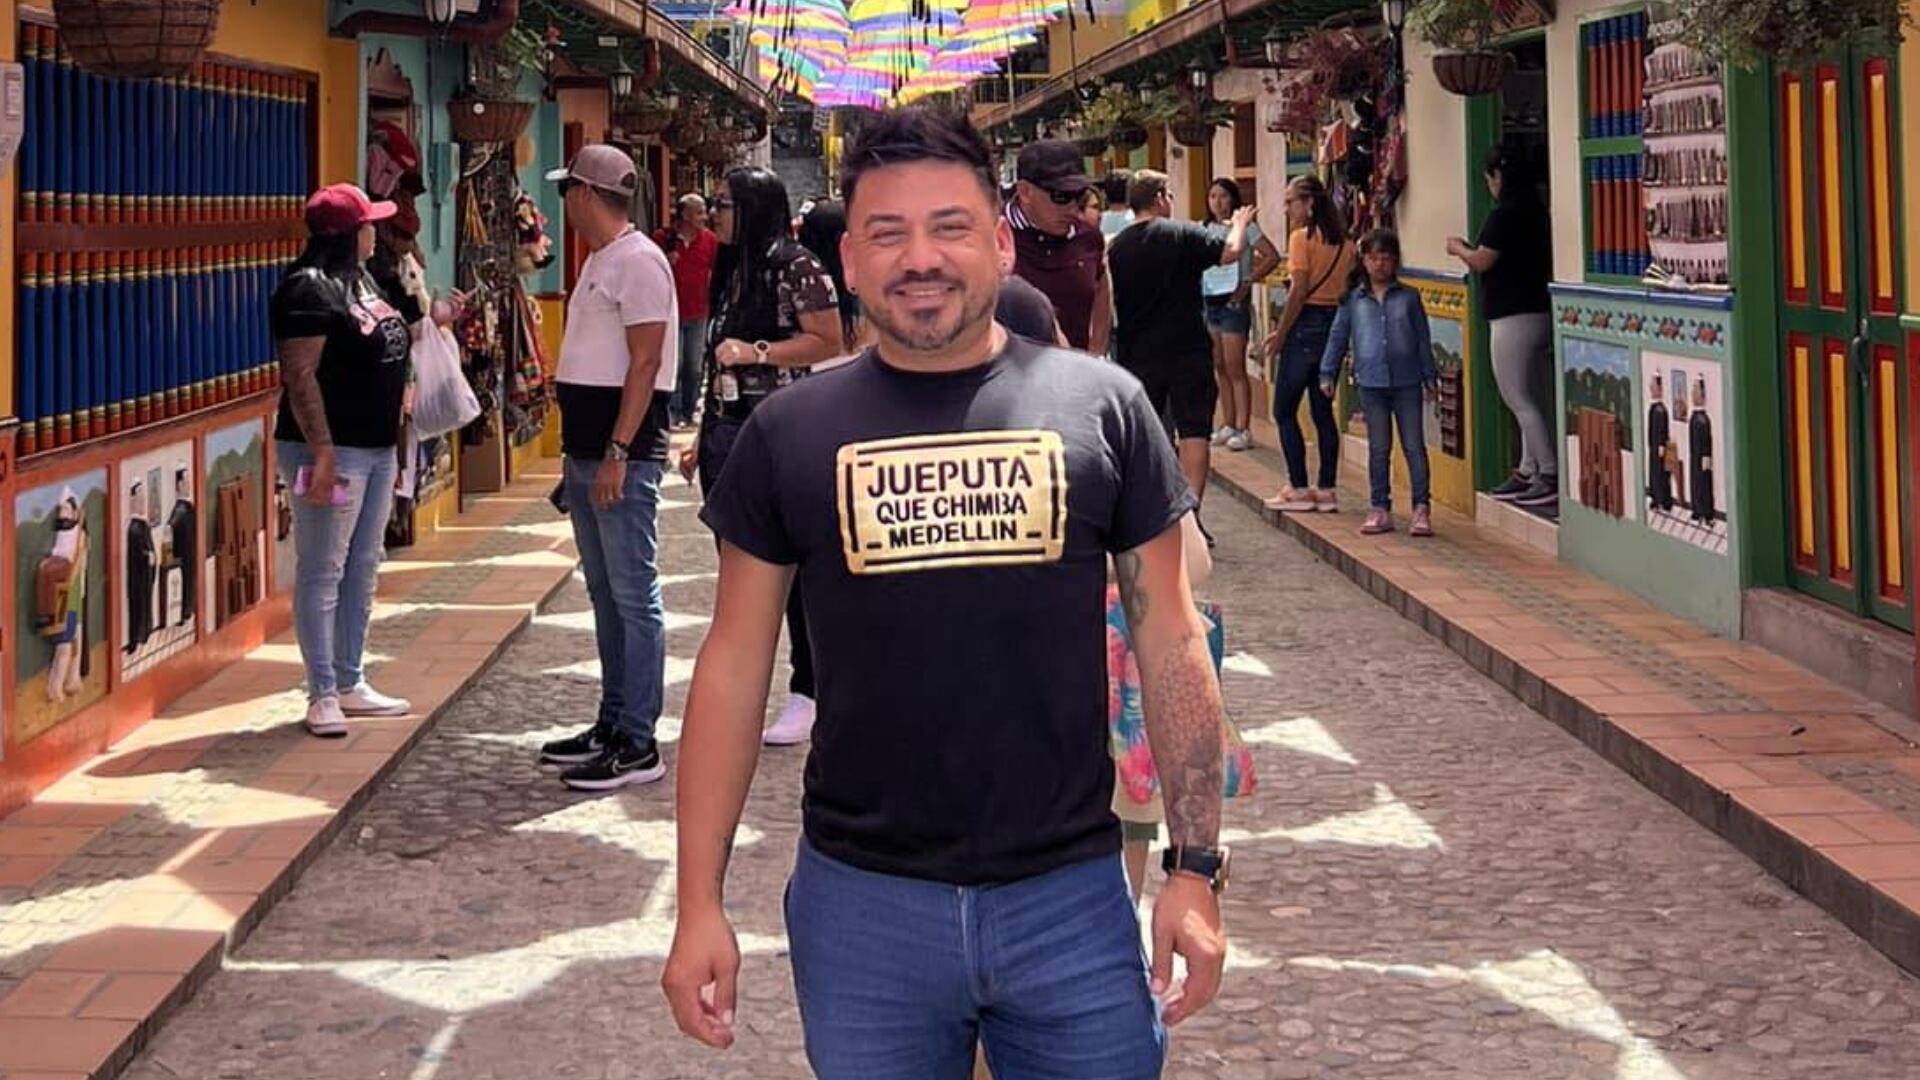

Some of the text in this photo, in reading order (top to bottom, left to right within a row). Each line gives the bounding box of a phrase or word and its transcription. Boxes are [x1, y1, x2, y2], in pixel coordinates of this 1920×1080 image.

[868, 457, 1032, 497] JUEPUTA
[876, 493, 1027, 524] QUE CHIMBA
[889, 521, 1018, 549] MEDELLIN
